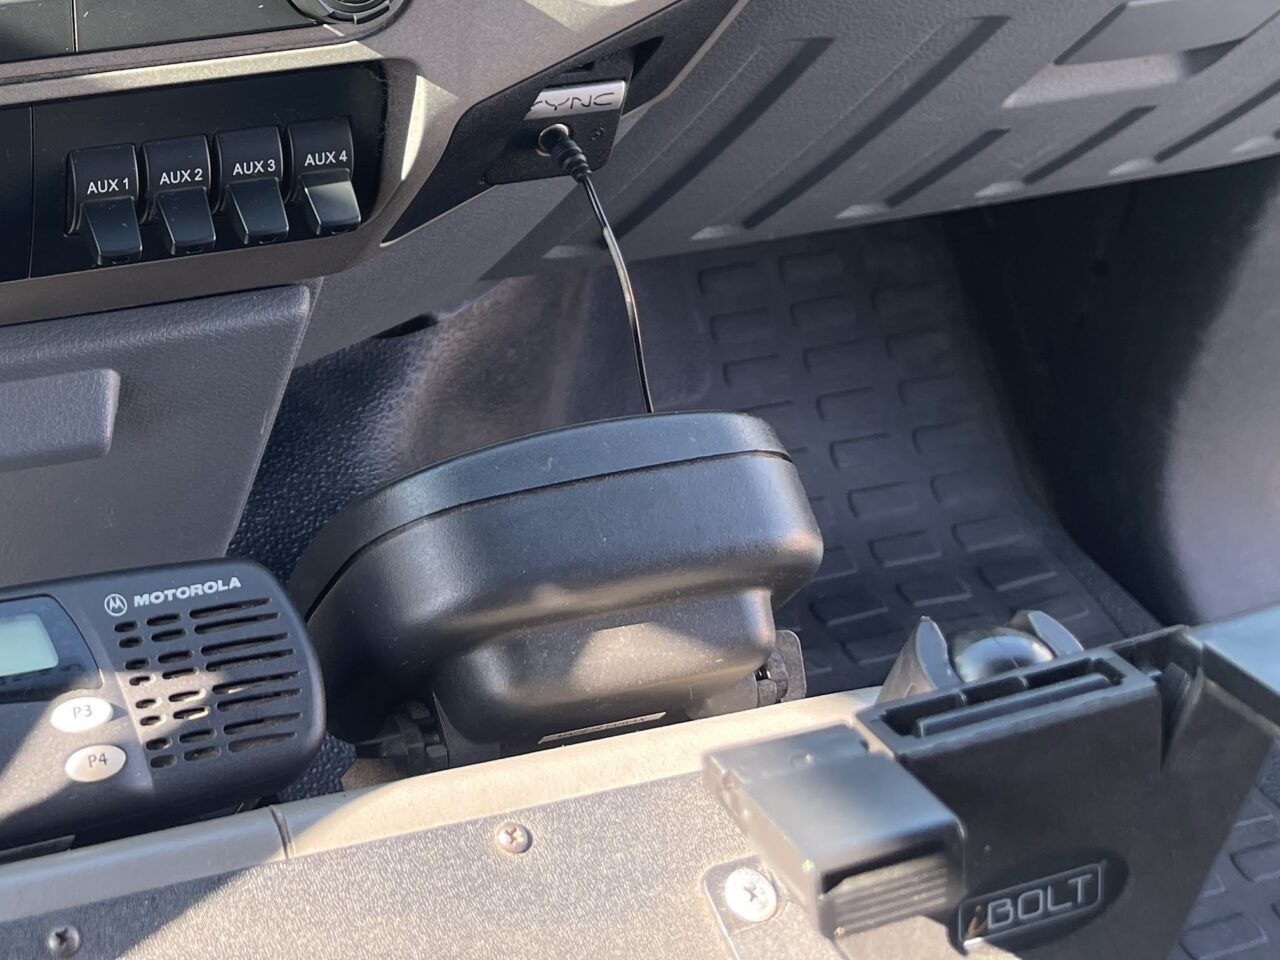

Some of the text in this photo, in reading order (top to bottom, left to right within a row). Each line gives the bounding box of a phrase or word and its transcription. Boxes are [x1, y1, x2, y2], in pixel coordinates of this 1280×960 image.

[304, 150, 348, 167] AUX 4
[232, 159, 276, 176] AUX 3
[159, 168, 203, 185] AUX 2
[87, 177, 130, 195] AUX 1
[133, 576, 242, 607] MOTOROLA
[72, 704, 93, 719] P3
[88, 752, 108, 769] P4
